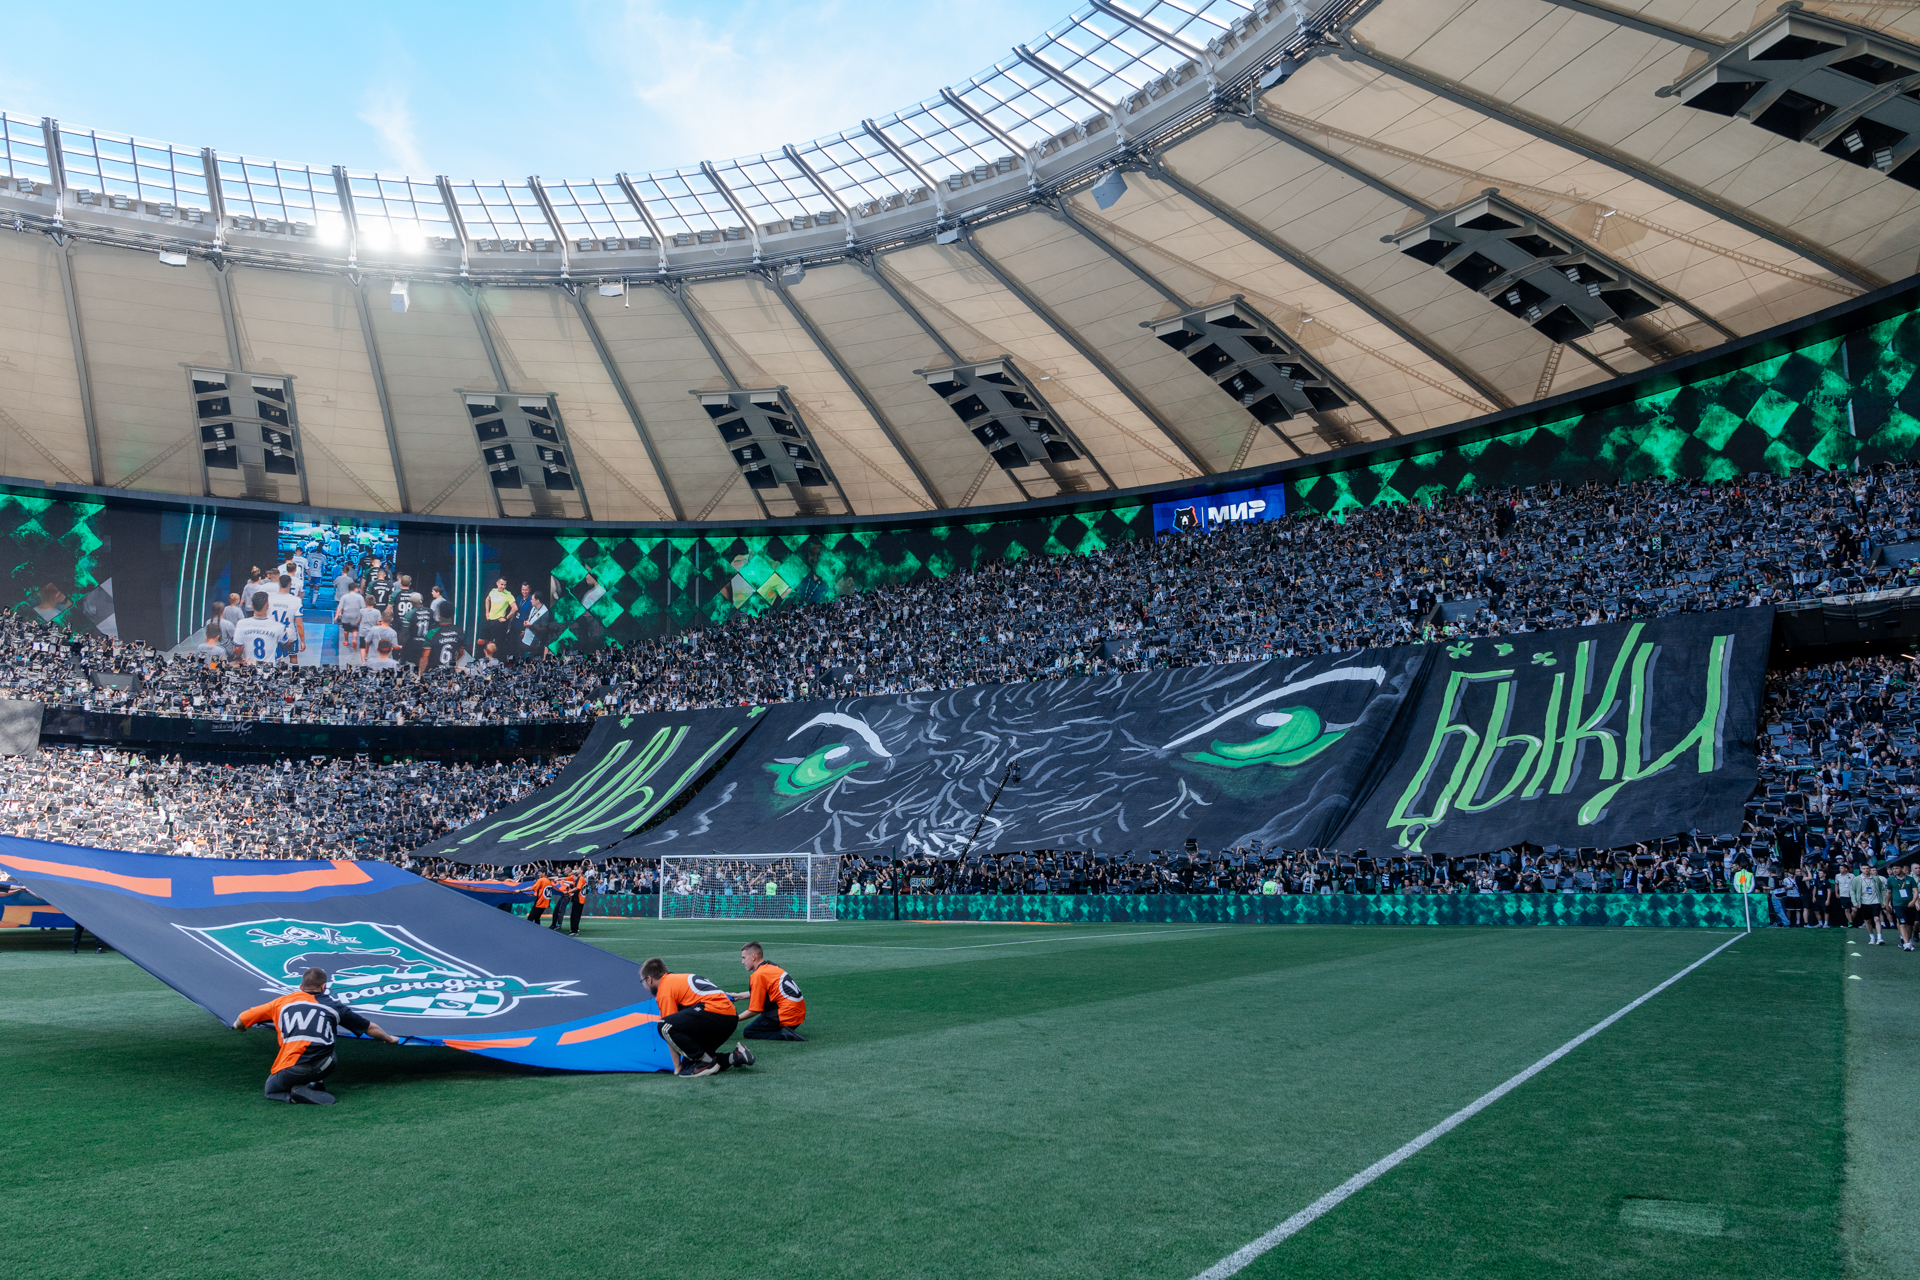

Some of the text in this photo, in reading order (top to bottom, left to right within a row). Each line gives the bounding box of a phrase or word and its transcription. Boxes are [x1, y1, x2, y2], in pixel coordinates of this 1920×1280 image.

[1208, 499, 1266, 523] МИР
[377, 589, 386, 603] 7
[272, 610, 291, 628] 14
[416, 620, 429, 637] 11
[253, 637, 266, 660] 8
[440, 643, 453, 664] 6
[325, 978, 506, 1004] раснодар
